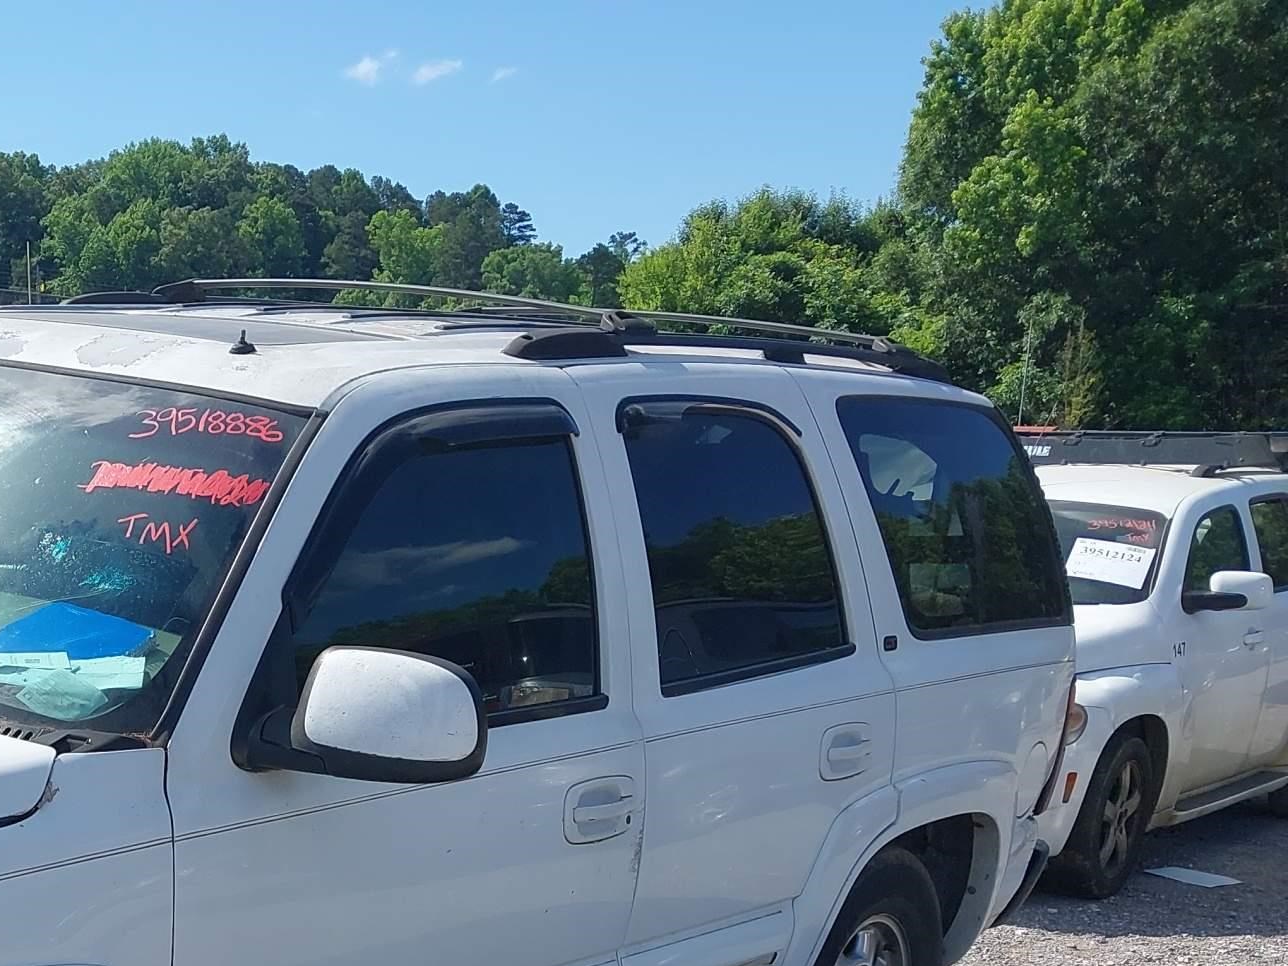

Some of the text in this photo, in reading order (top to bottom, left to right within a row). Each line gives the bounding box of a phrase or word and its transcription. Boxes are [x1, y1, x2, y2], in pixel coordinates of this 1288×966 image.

[128, 408, 283, 441] 39518886
[118, 513, 197, 553] TMX
[1080, 546, 1142, 563] 39512124
[1173, 642, 1186, 657] 147
